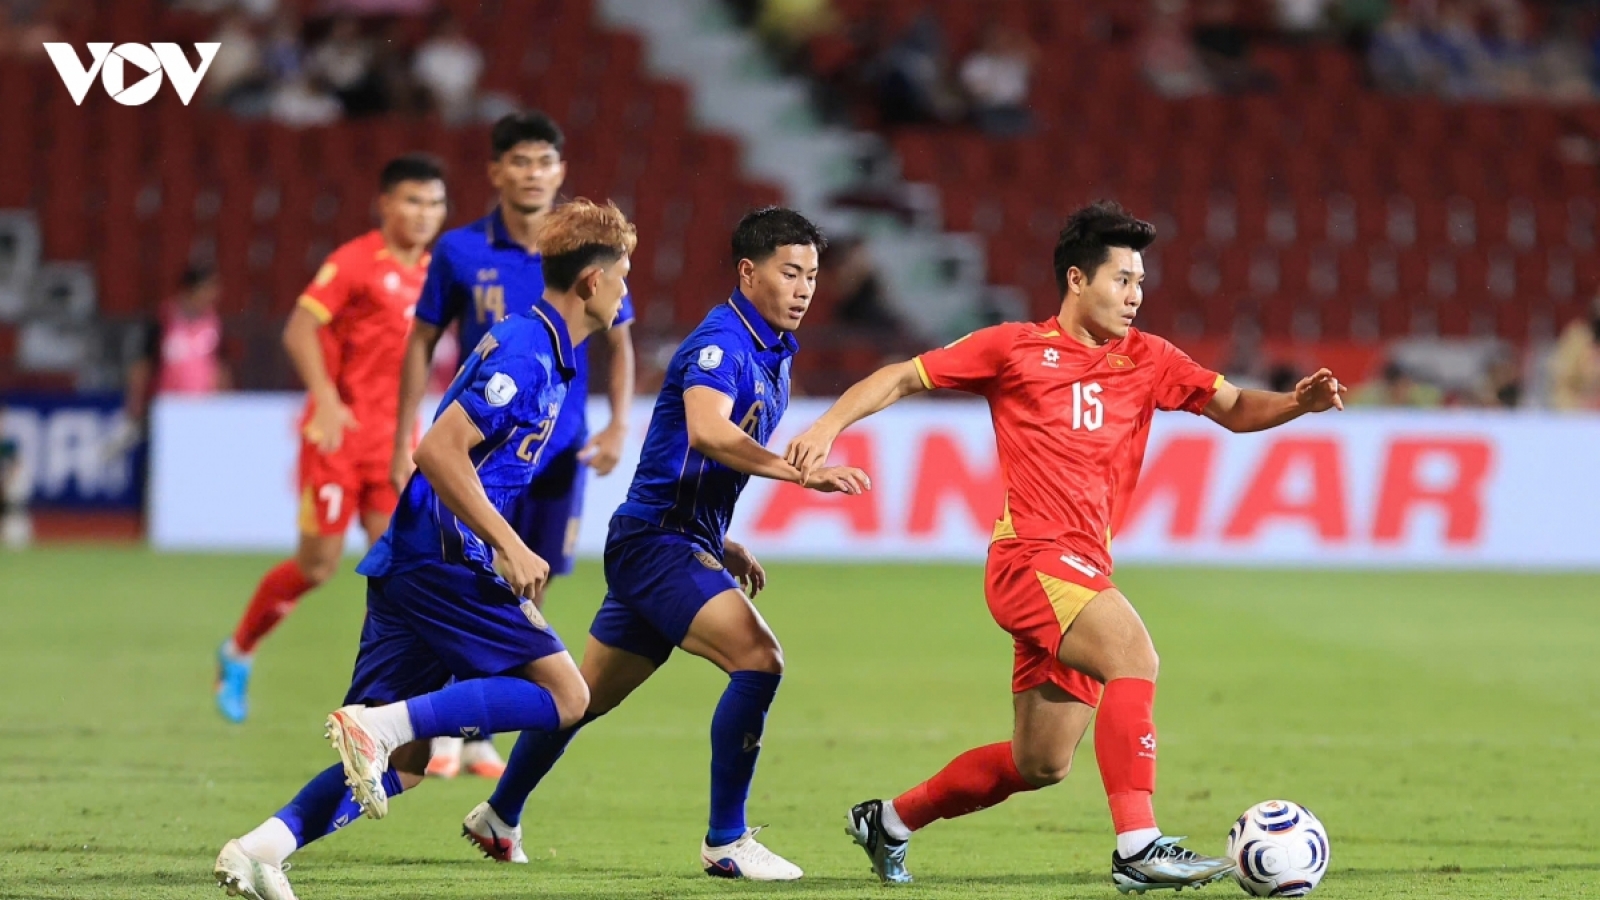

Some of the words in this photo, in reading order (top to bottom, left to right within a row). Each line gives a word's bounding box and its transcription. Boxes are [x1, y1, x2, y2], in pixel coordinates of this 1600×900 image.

[472, 284, 505, 324] 14
[1071, 382, 1104, 431] 15
[752, 430, 1494, 545] ANMAR
